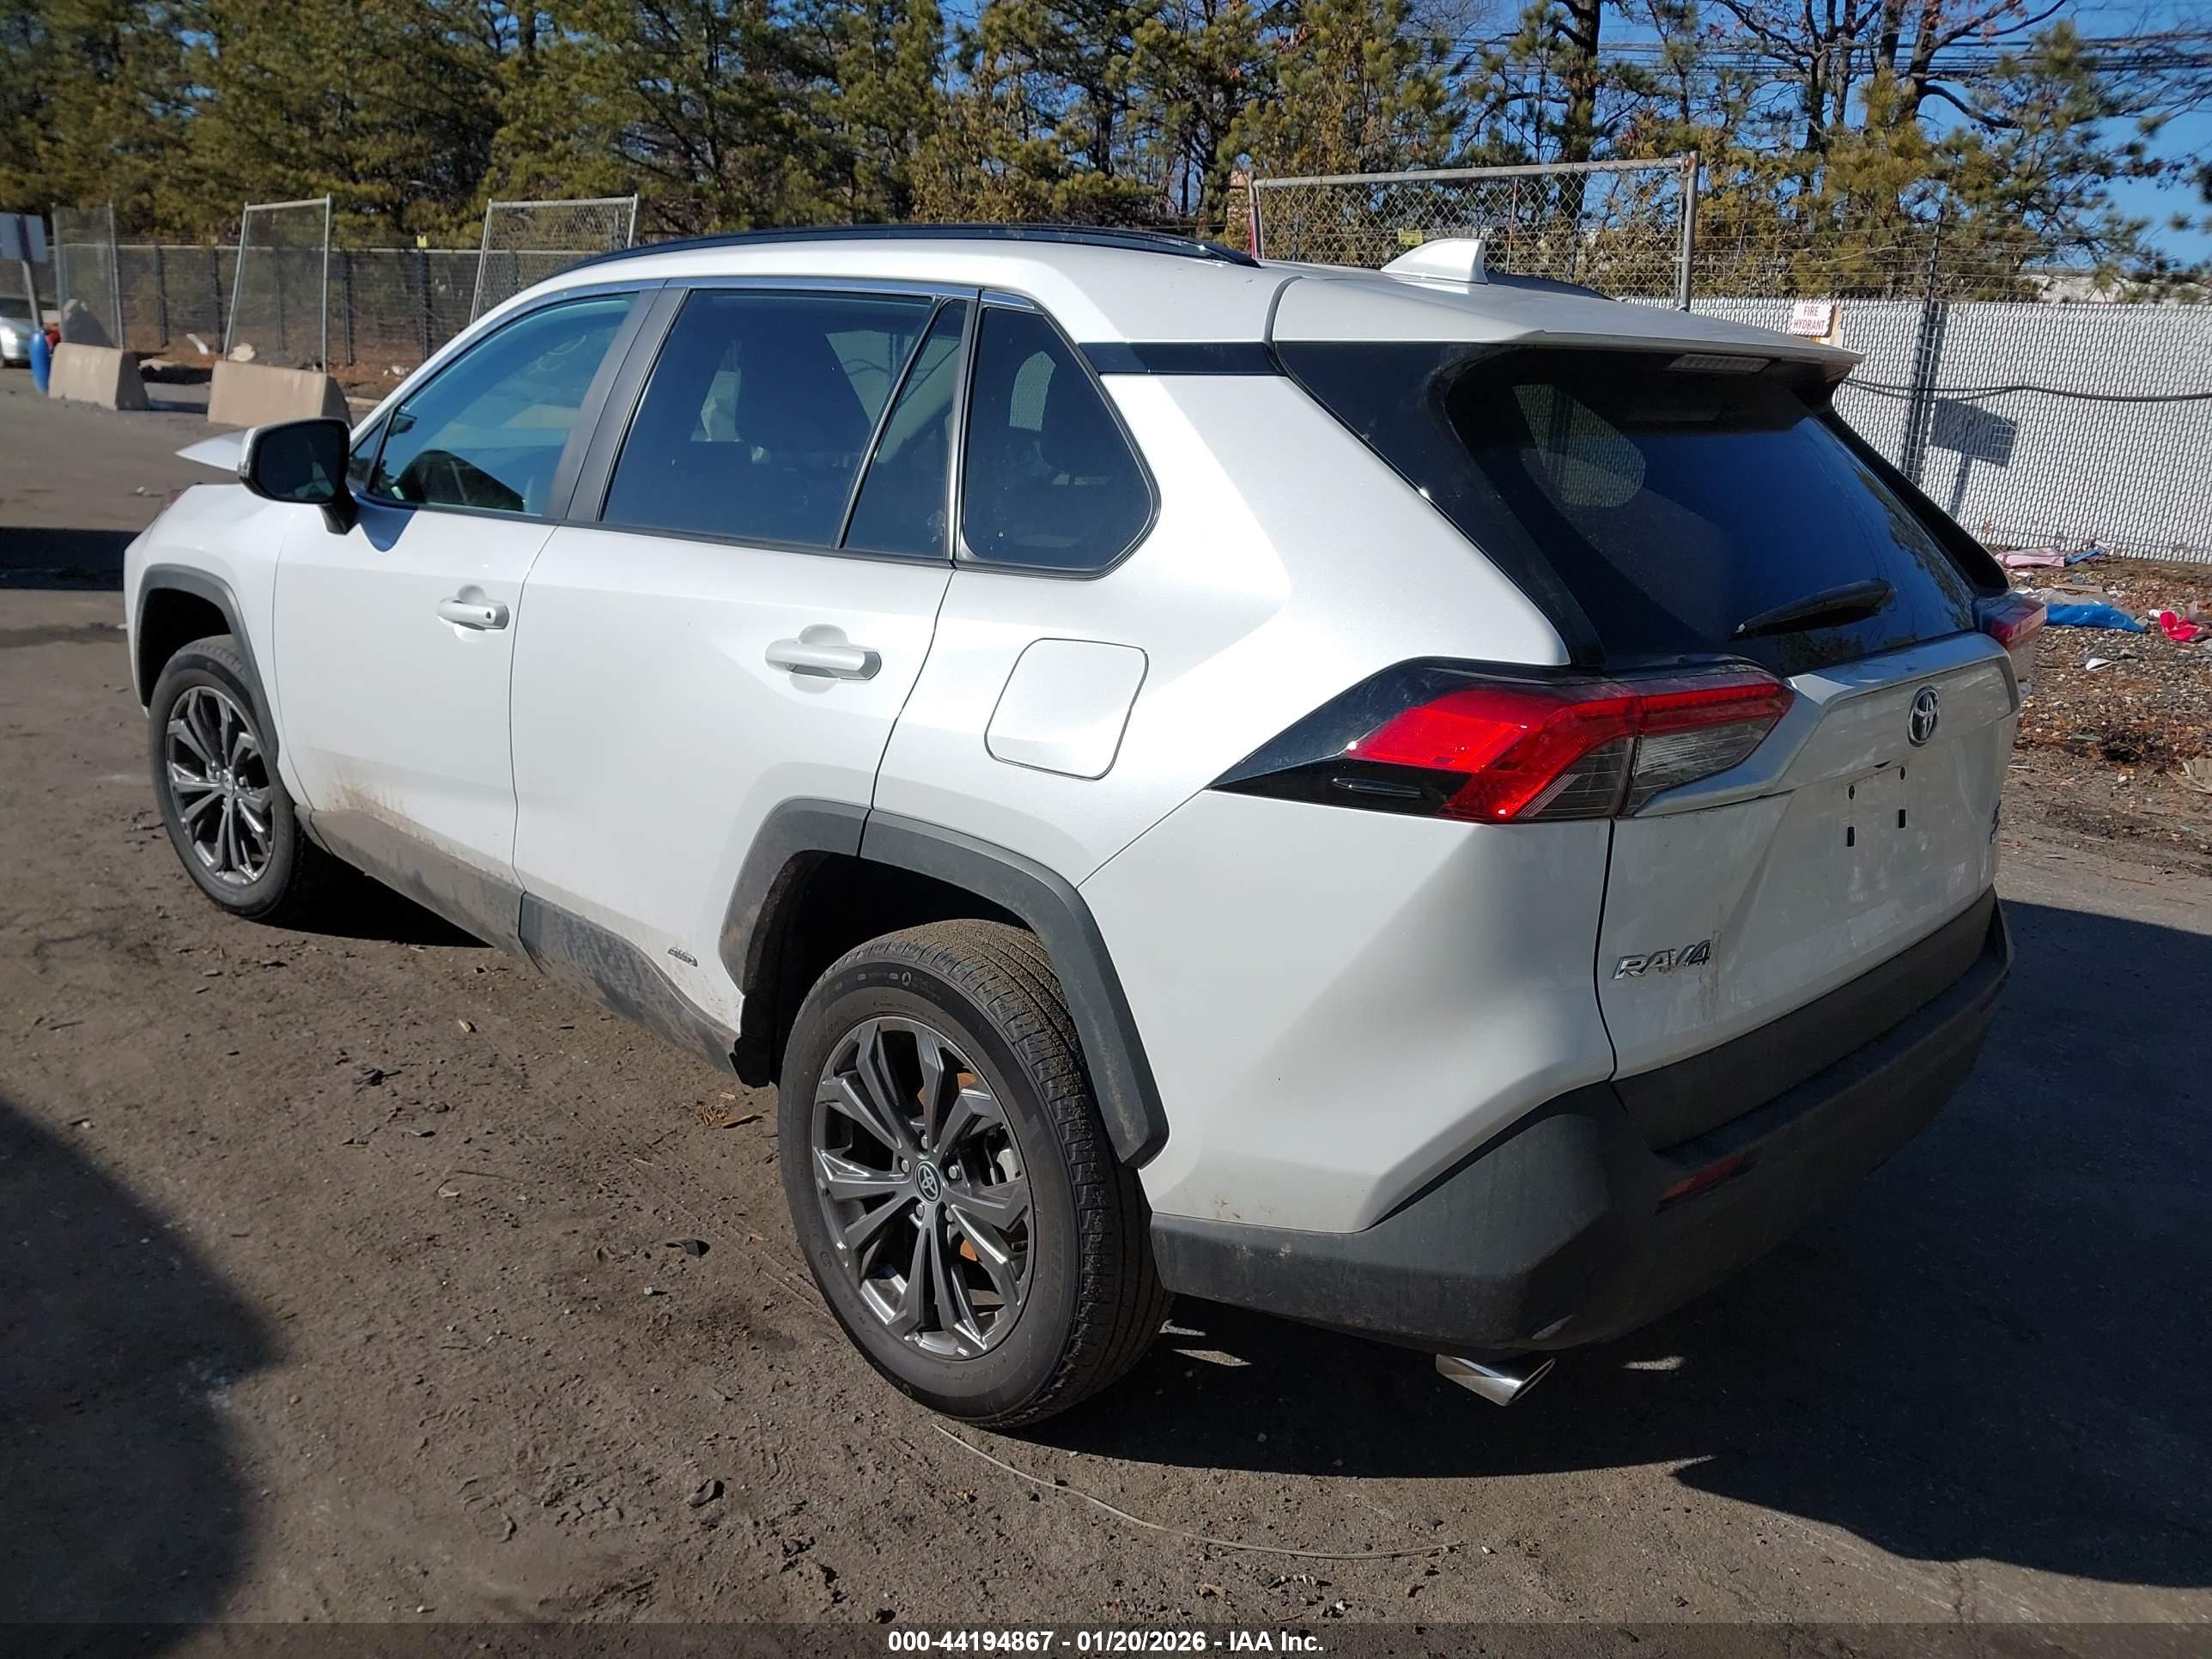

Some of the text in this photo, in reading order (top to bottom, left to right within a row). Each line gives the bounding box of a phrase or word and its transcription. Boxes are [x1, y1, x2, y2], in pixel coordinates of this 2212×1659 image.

[1803, 306, 1820, 317] FIRE
[1793, 319, 1826, 331] HYDRANT
[1612, 939, 1711, 980] RAV4
